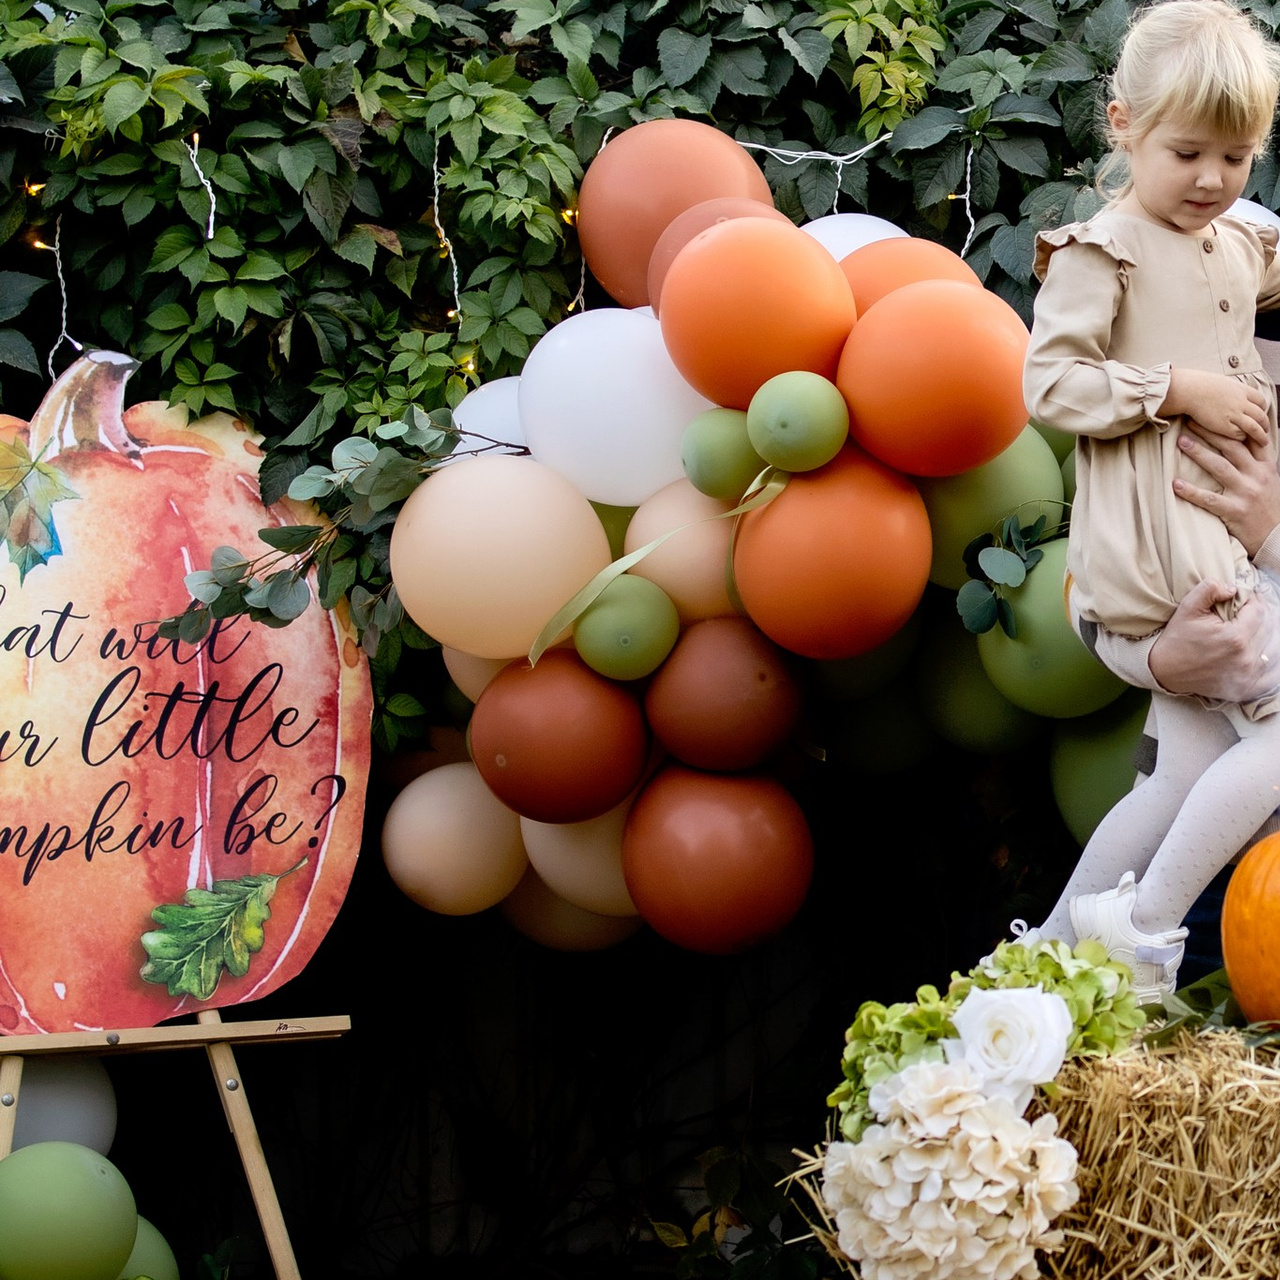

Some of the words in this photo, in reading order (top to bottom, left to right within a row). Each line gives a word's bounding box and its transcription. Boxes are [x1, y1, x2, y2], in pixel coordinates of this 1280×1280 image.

[0, 584, 90, 663] at
[81, 662, 320, 767] little
[223, 774, 347, 856] be?
